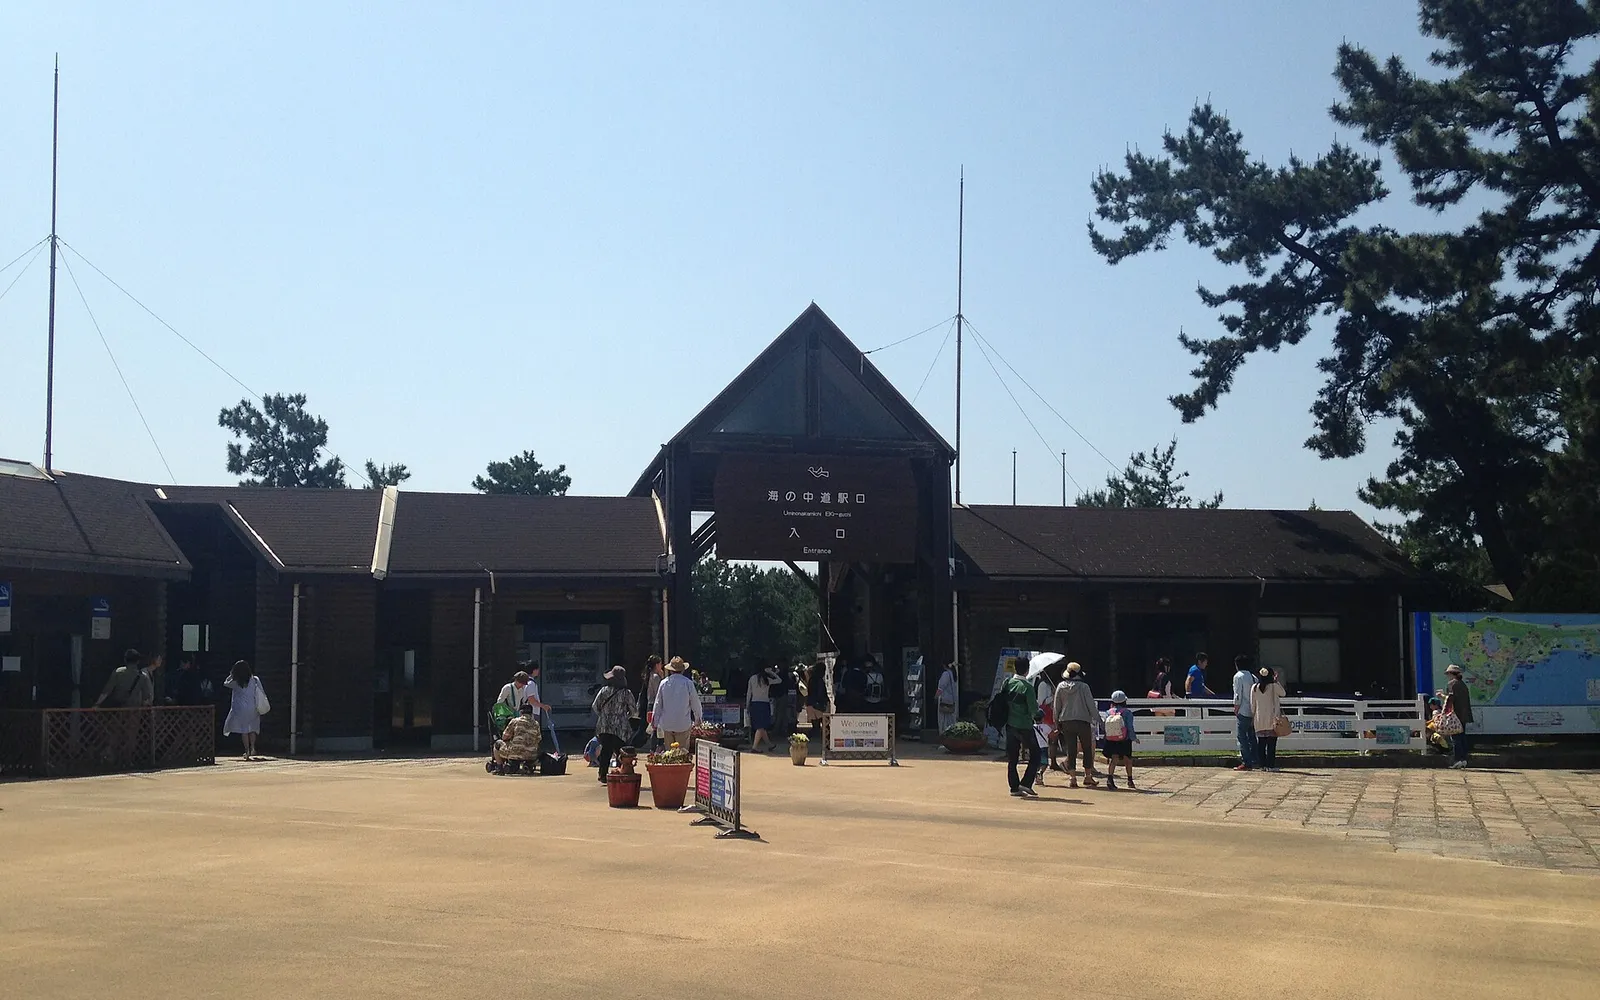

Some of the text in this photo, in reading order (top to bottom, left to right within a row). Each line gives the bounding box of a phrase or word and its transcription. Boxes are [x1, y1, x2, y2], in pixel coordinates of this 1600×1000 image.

[768, 490, 865, 503] 海の中道駅口
